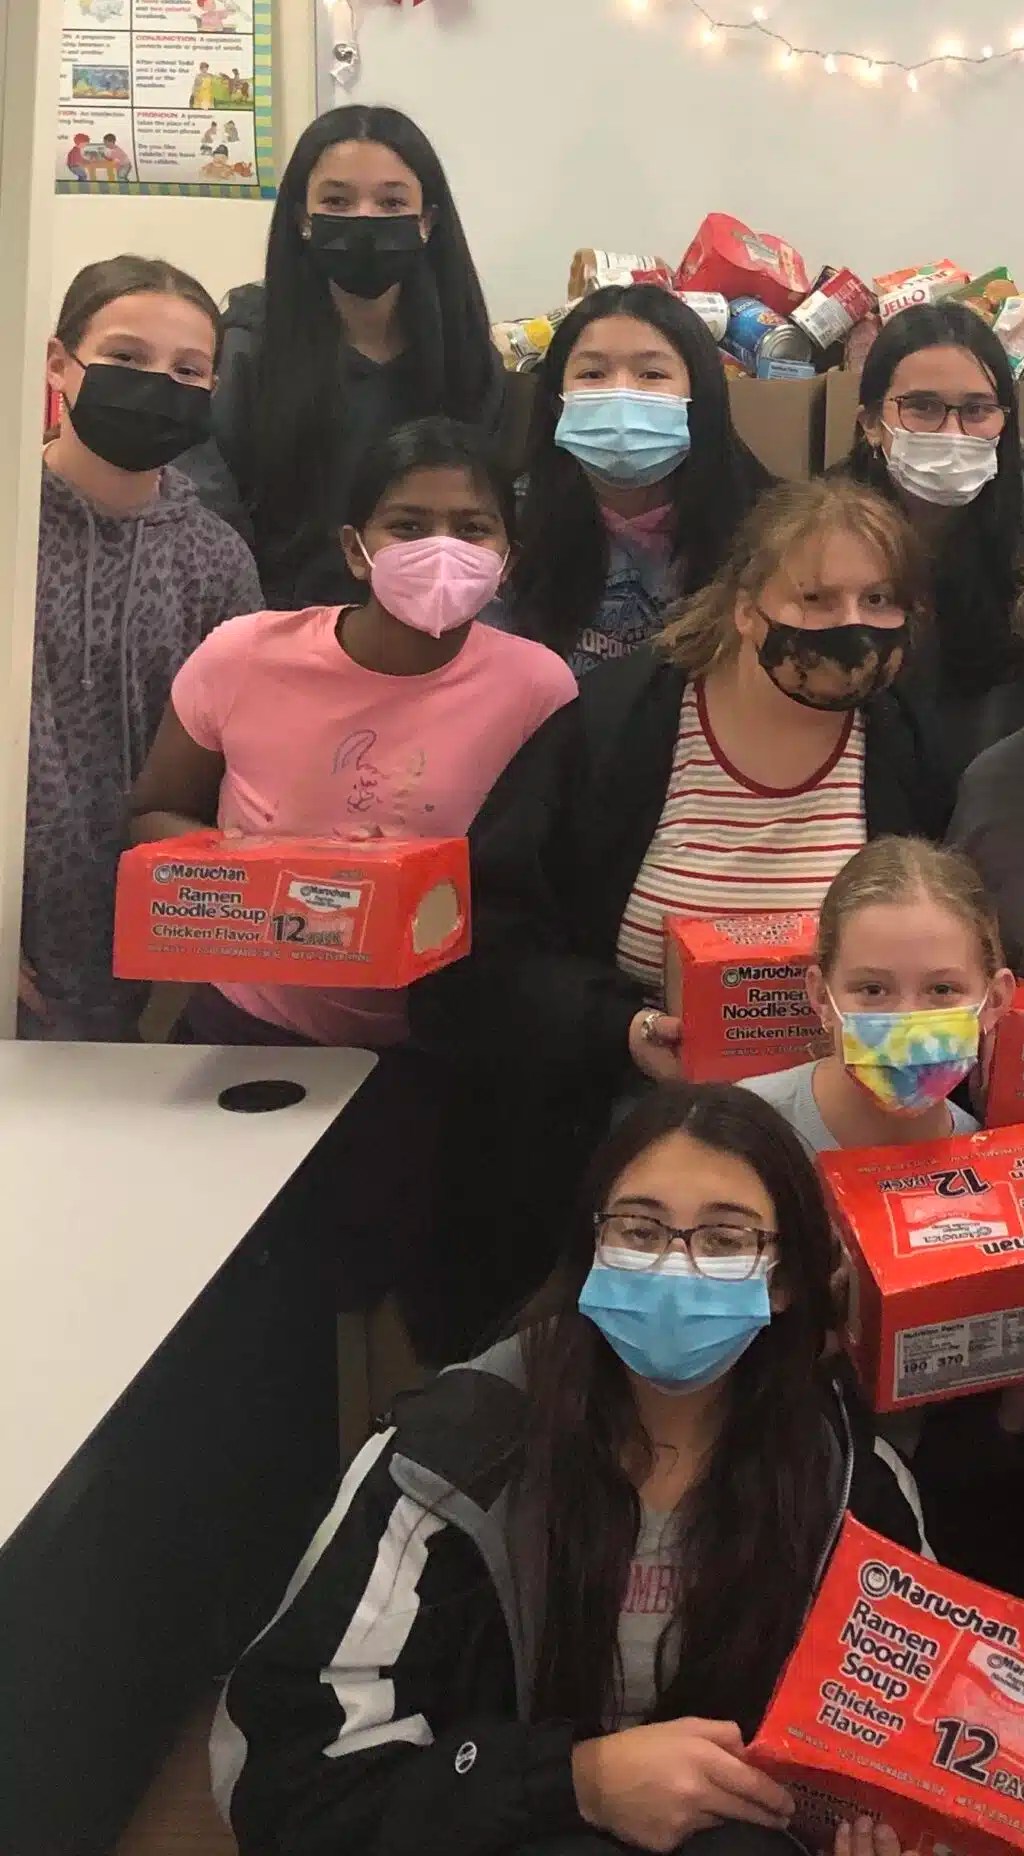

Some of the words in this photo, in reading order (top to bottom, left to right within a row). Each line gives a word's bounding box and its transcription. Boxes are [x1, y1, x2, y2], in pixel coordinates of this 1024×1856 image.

[170, 864, 245, 882] Maruchan
[178, 886, 242, 903] Ramen
[151, 901, 217, 919] Noodle
[219, 904, 266, 924] Soup
[152, 924, 212, 939] Chicken
[215, 927, 260, 941] Flavor
[273, 915, 307, 942] 12
[723, 1003, 787, 1020] Noodle
[725, 1027, 785, 1041] Chicken
[787, 1024, 825, 1040] Flavo
[877, 1175, 932, 1193] PACK
[927, 1166, 993, 1200] 12
[888, 1567, 1020, 1647] Maruchan
[850, 1598, 940, 1659] Ramen
[839, 1618, 933, 1684] Noodle
[840, 1650, 909, 1703] Soup
[818, 1678, 905, 1735] Chicken
[816, 1701, 890, 1749] Flavor
[933, 1717, 999, 1786] 12
